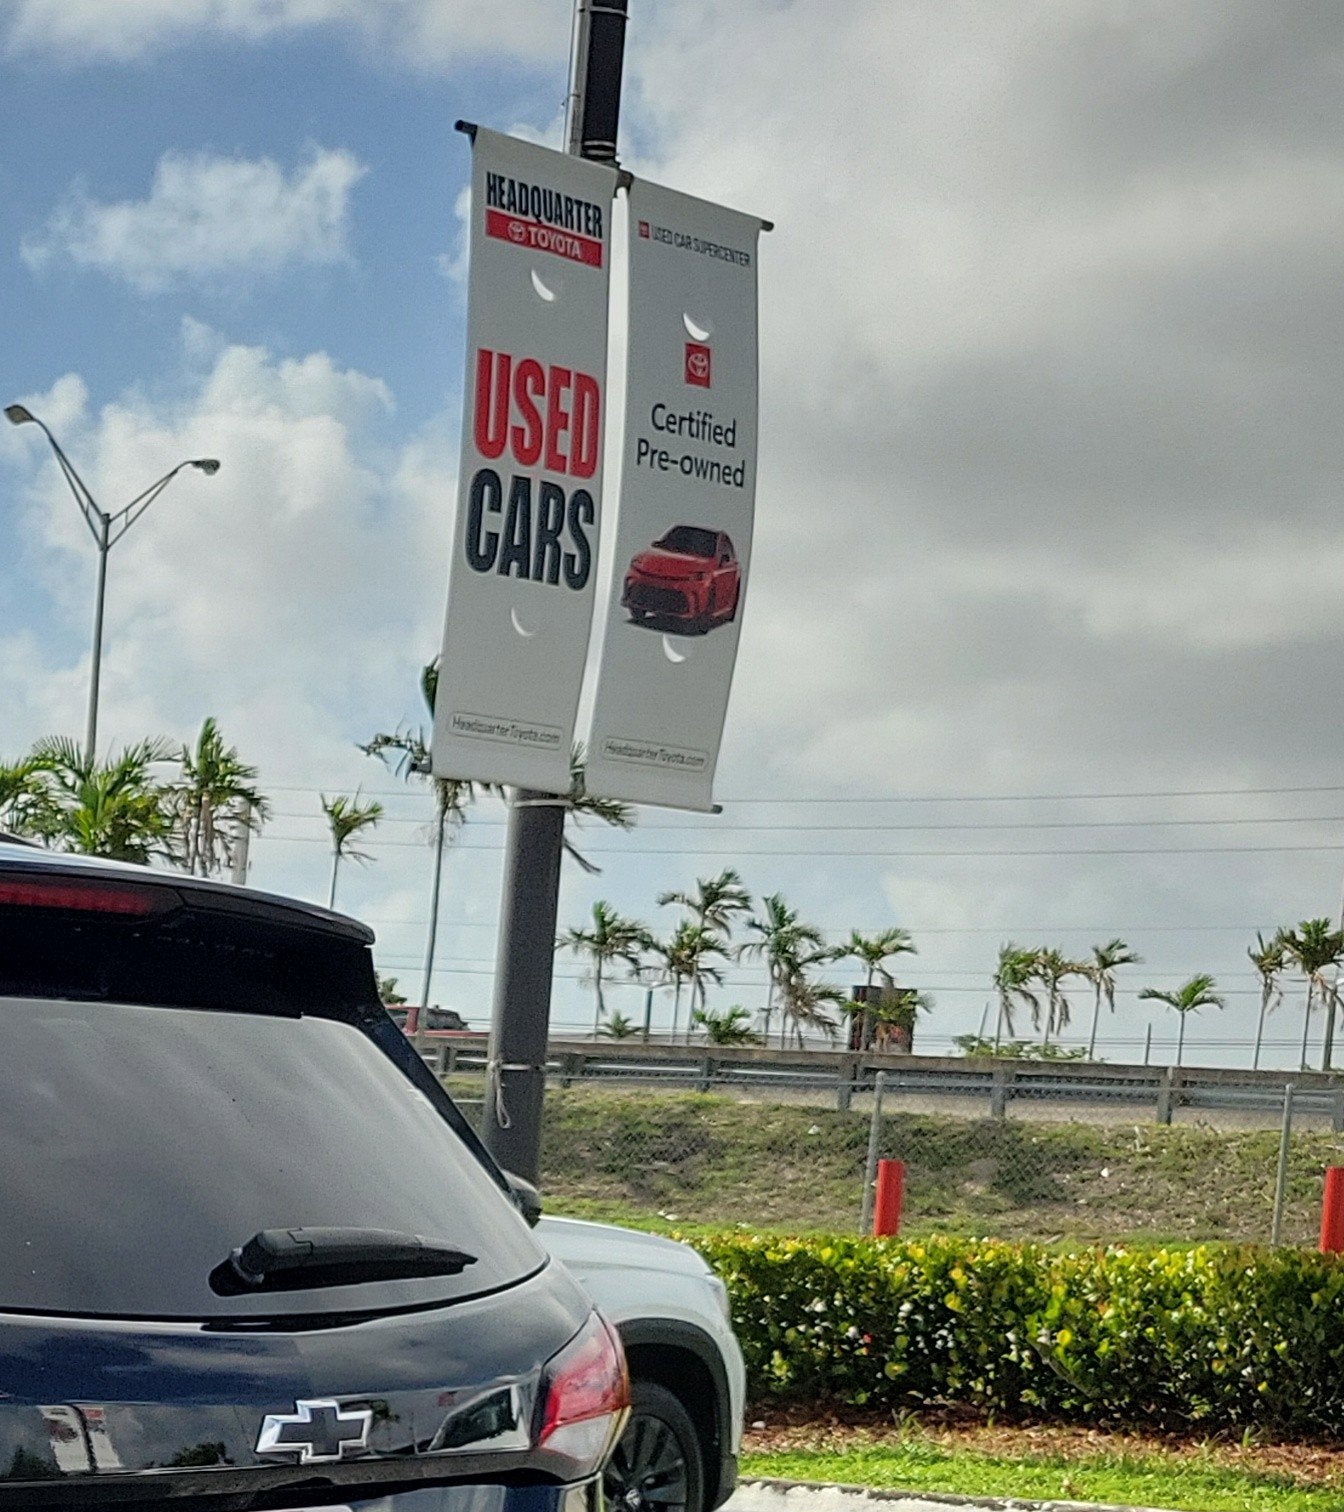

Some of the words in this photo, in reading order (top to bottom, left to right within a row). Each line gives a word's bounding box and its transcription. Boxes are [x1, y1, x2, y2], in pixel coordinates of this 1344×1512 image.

[486, 171, 603, 239] HEADQUARTER
[528, 227, 583, 259] TOYOTA
[474, 348, 600, 479] USED
[652, 403, 736, 448] Certified
[638, 438, 745, 488] Pre-owned
[465, 468, 594, 591] CARS
